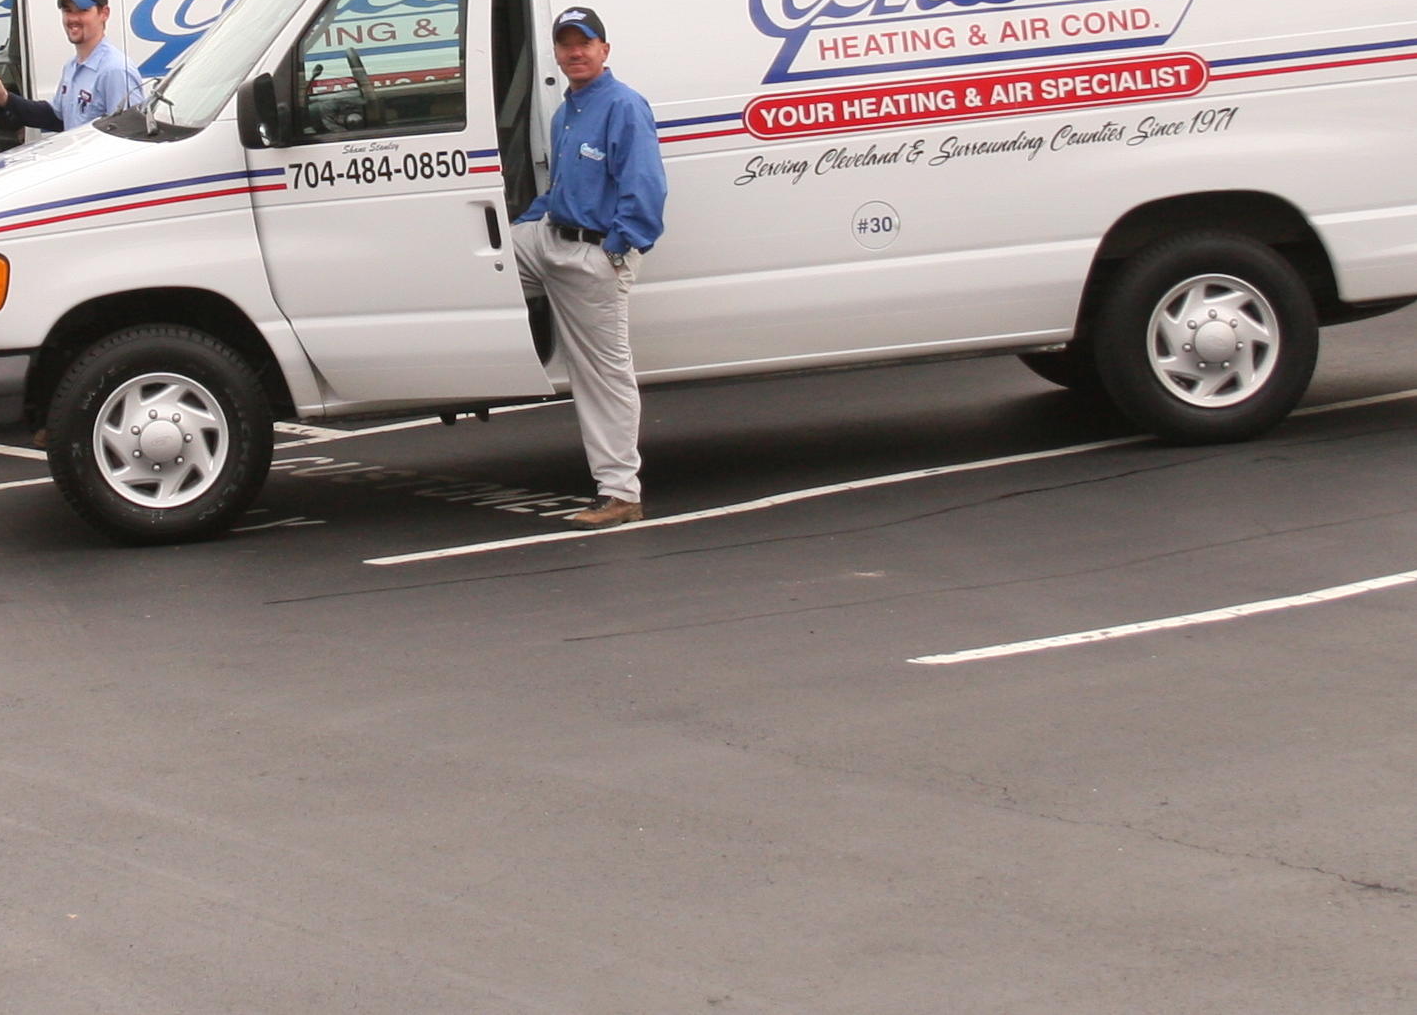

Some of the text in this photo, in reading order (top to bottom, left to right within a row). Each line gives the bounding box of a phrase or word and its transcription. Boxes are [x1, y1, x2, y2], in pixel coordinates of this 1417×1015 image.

[817, 7, 1161, 61] HEATING & AIR COND.
[759, 65, 1192, 129] YOUR HEATING & AIR SPECIALIST
[288, 149, 467, 190] 704-484-0850
[733, 107, 1239, 186] Serving Cleveland & Surrounding Counties Since 1971
[855, 215, 894, 235] #30
